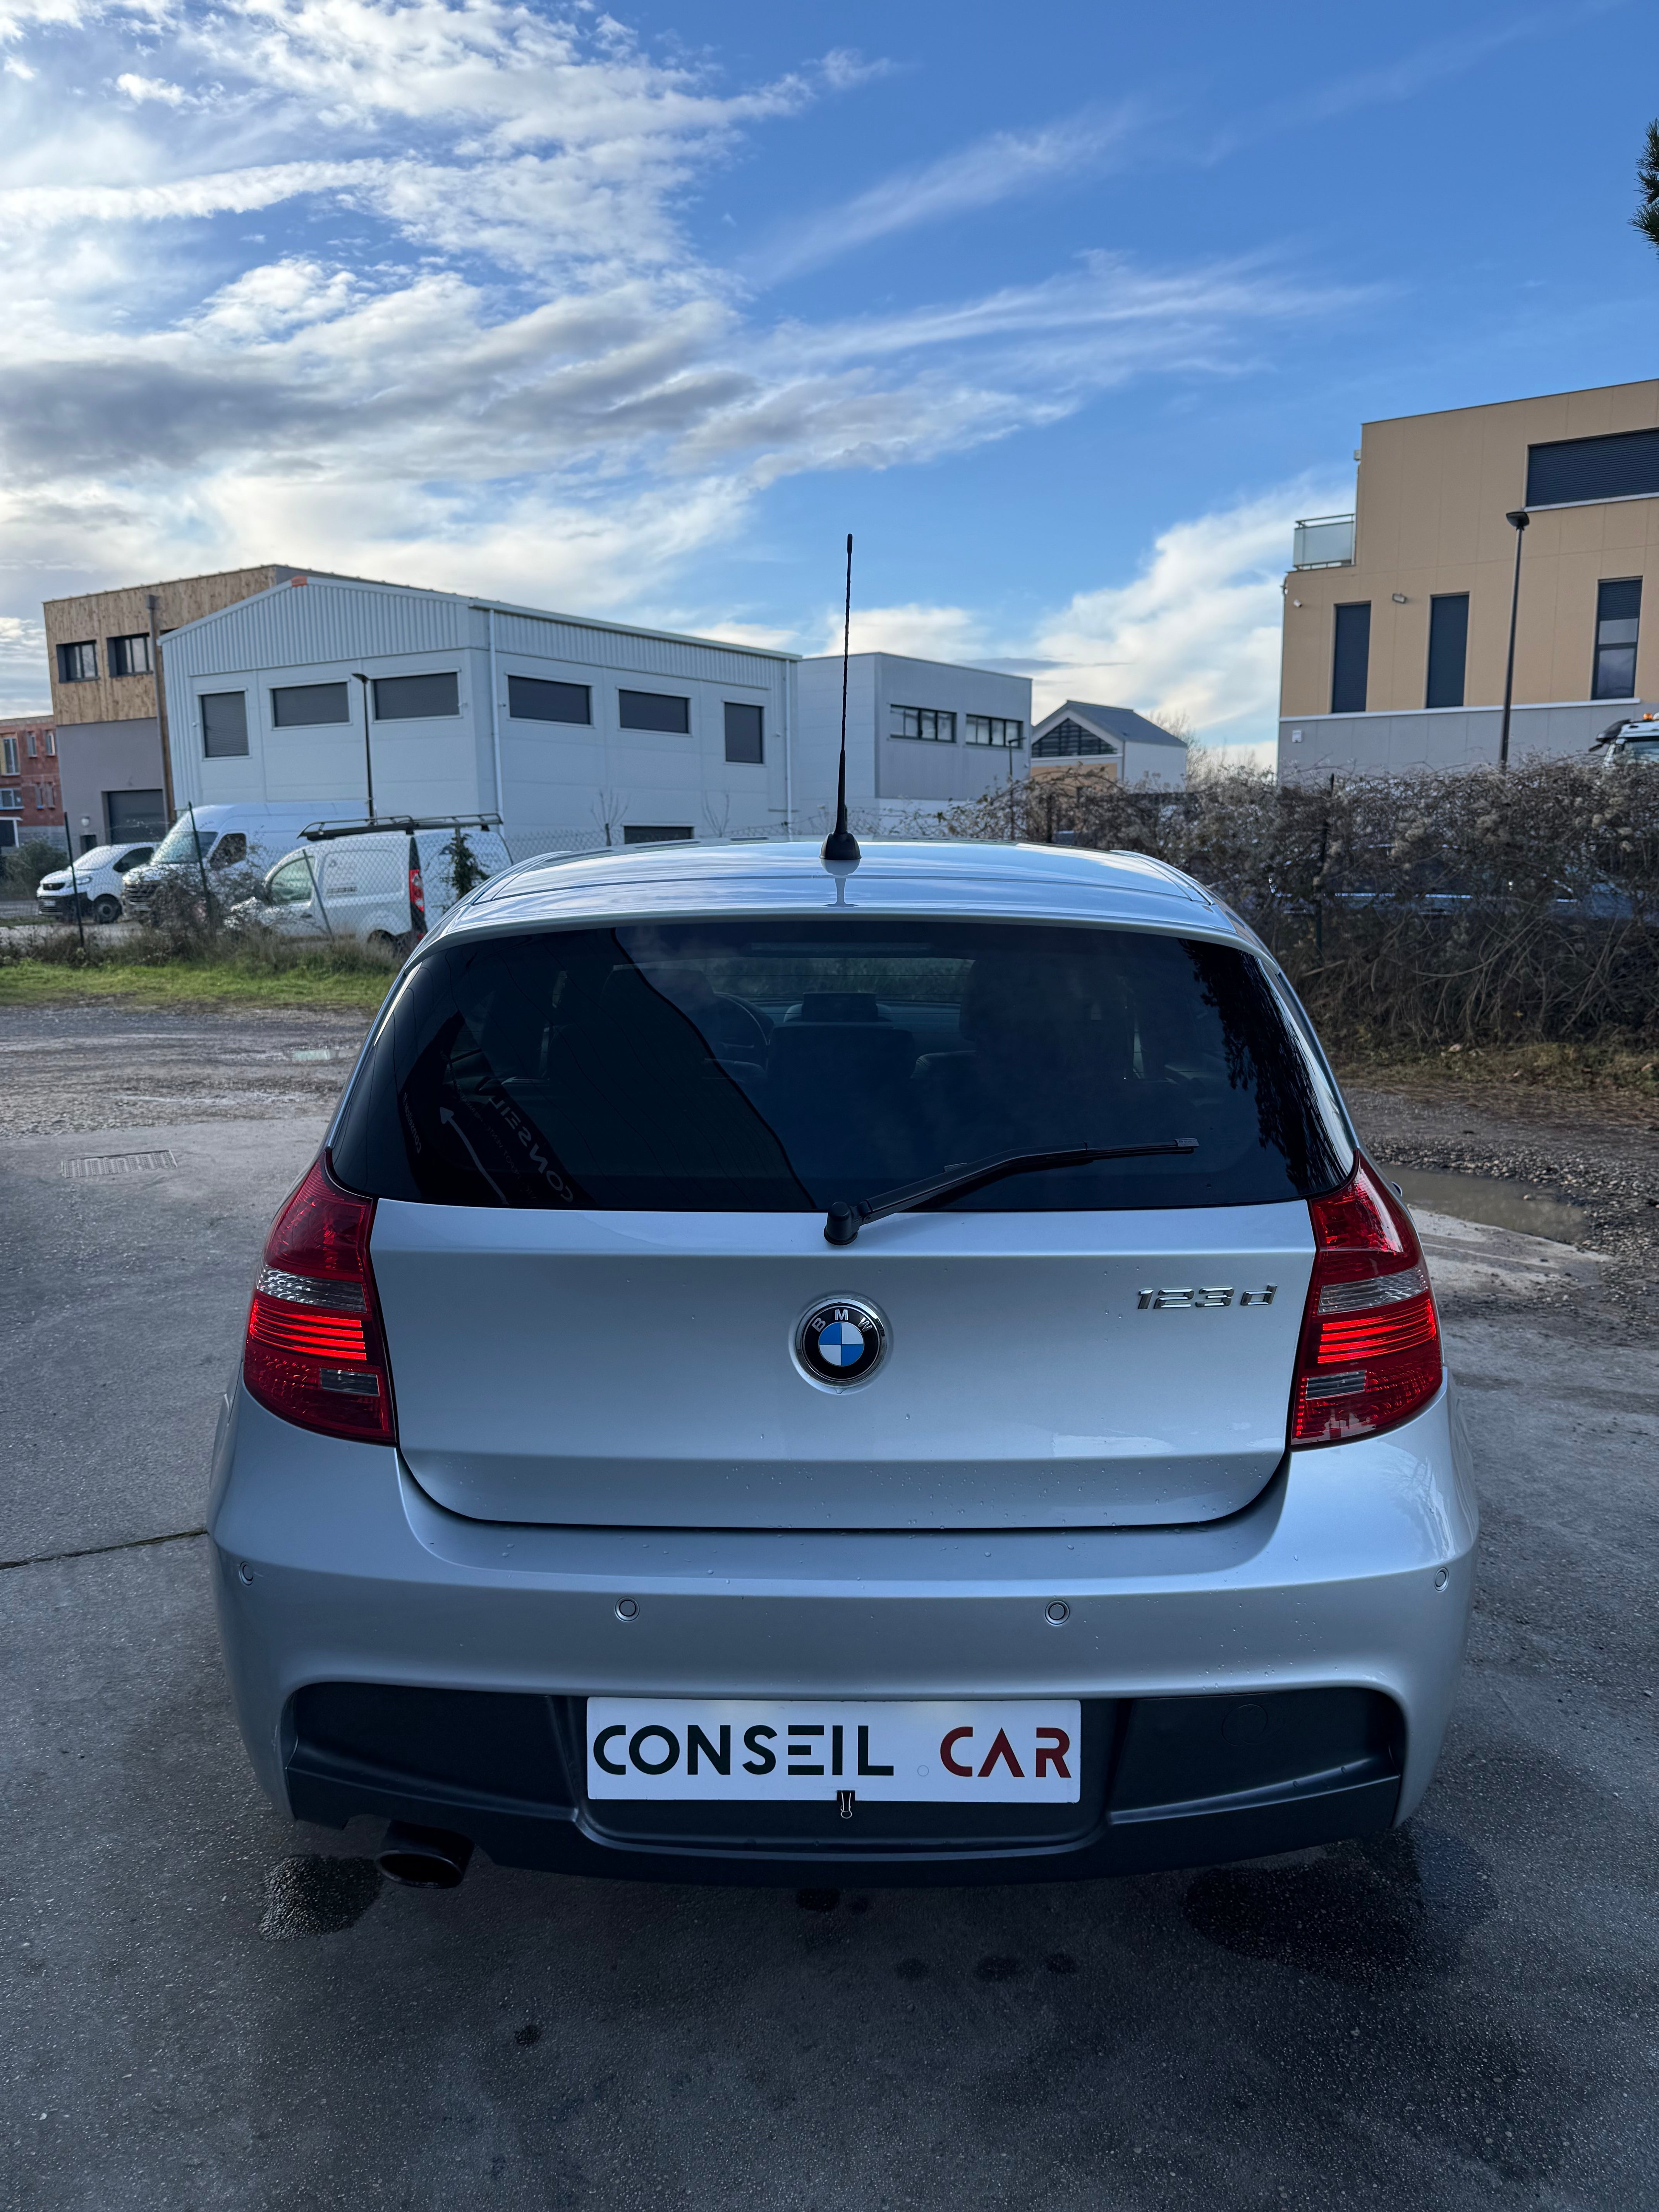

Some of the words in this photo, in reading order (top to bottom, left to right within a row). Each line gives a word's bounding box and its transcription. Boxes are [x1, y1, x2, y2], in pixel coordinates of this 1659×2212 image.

[1138, 1284, 1278, 1310] 123d
[811, 1309, 872, 1333] BMW
[593, 1725, 894, 1776] CONSEIL
[940, 1726, 1072, 1778] CAR
